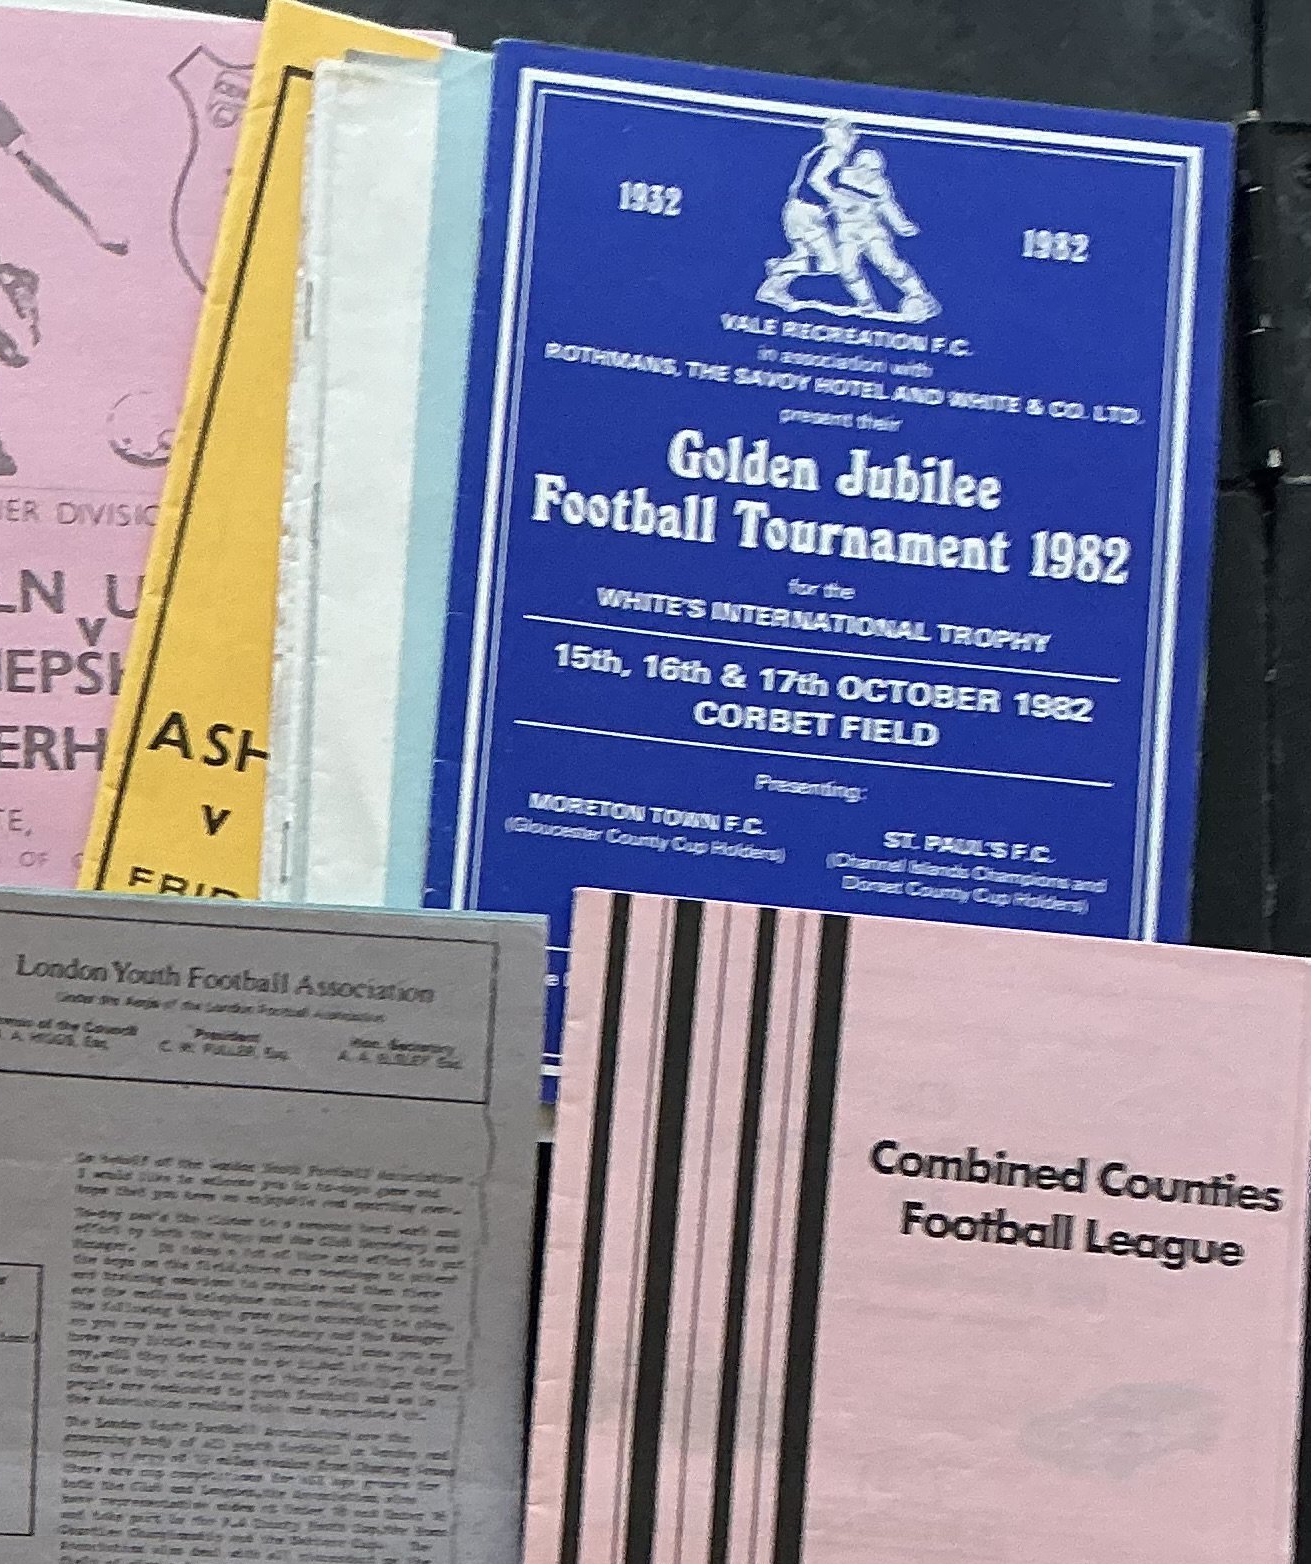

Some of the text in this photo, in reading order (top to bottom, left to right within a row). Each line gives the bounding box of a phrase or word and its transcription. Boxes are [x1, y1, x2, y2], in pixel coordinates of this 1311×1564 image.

[720, 313, 974, 357] VALE RECREATION F.C.
[544, 342, 682, 377] ROTHMANS,
[684, 361, 731, 383] THE
[733, 367, 812, 391] SAVOY
[814, 377, 890, 400] HOTEL
[890, 385, 945, 406] AND
[946, 391, 1022, 413] WHITE
[1024, 398, 1045, 416] &
[1092, 405, 1143, 425] LTD.
[756, 348, 934, 378] in association with
[779, 408, 904, 432] present their
[667, 428, 1002, 510] Golden Jubilee
[531, 473, 1131, 585] Football Tournament 1982
[788, 578, 856, 600] for the
[596, 587, 1052, 653] WHITE'S INTERNATIONAL TROPHY
[554, 643, 1094, 723] 15th, 16th & 17th OCTOBER 1982
[692, 700, 940, 747] CORBET FIELD
[754, 773, 868, 803] Presenting:
[528, 792, 768, 835] MORETON TOWN F.C.
[504, 816, 786, 864] (Gloucester County Cup Holders)
[883, 831, 1056, 864] ST. PAUL'S F.C.
[904, 881, 973, 904] County
[972, 887, 1012, 907] Cup
[15, 953, 436, 1004] London Youth Football Association
[869, 1139, 1283, 1213] Combined Counties
[900, 1200, 1245, 1271] Football League
